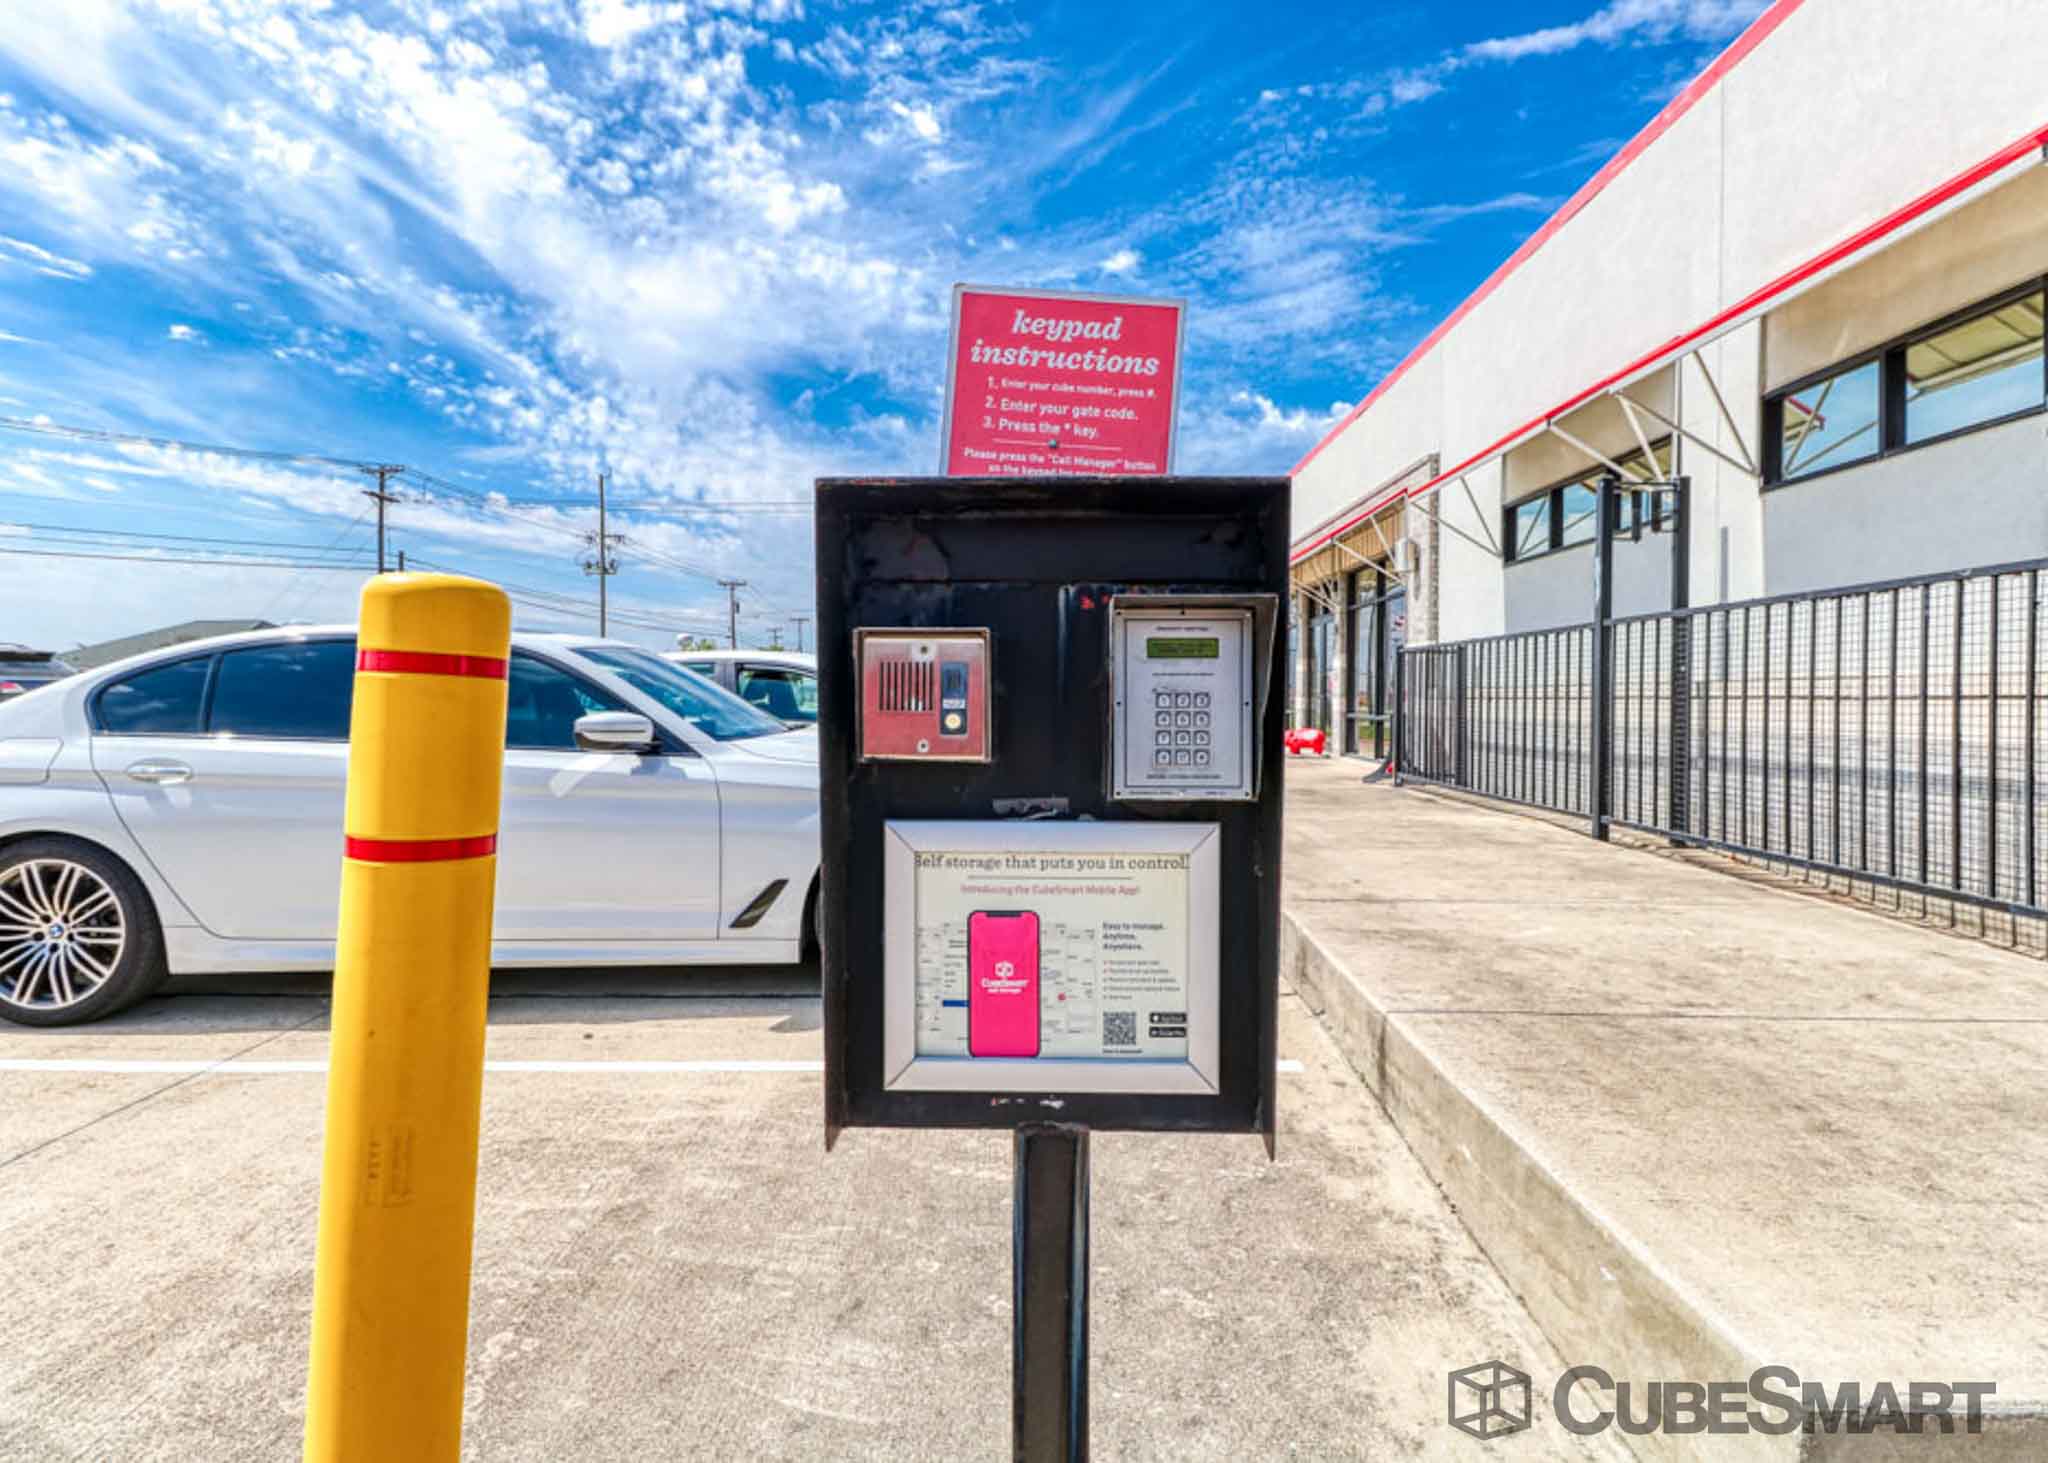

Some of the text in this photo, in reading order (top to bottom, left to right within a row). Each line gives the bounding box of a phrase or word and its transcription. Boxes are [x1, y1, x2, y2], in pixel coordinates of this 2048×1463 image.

[1012, 309, 1122, 342] keypad
[970, 338, 1160, 375] instructions
[988, 376, 999, 390] 1.
[985, 395, 1139, 421] 2. Enter your gate code.
[983, 415, 996, 429] 3.
[1000, 418, 1036, 432] Press
[1039, 421, 1060, 434] the
[964, 447, 997, 460] Please
[999, 453, 1026, 464] press
[914, 852, 944, 868] Self
[945, 857, 1002, 871] storage
[1005, 854, 1037, 869] that
[1040, 857, 1074, 872] puts
[1077, 858, 1107, 872] you
[1109, 855, 1125, 870] in
